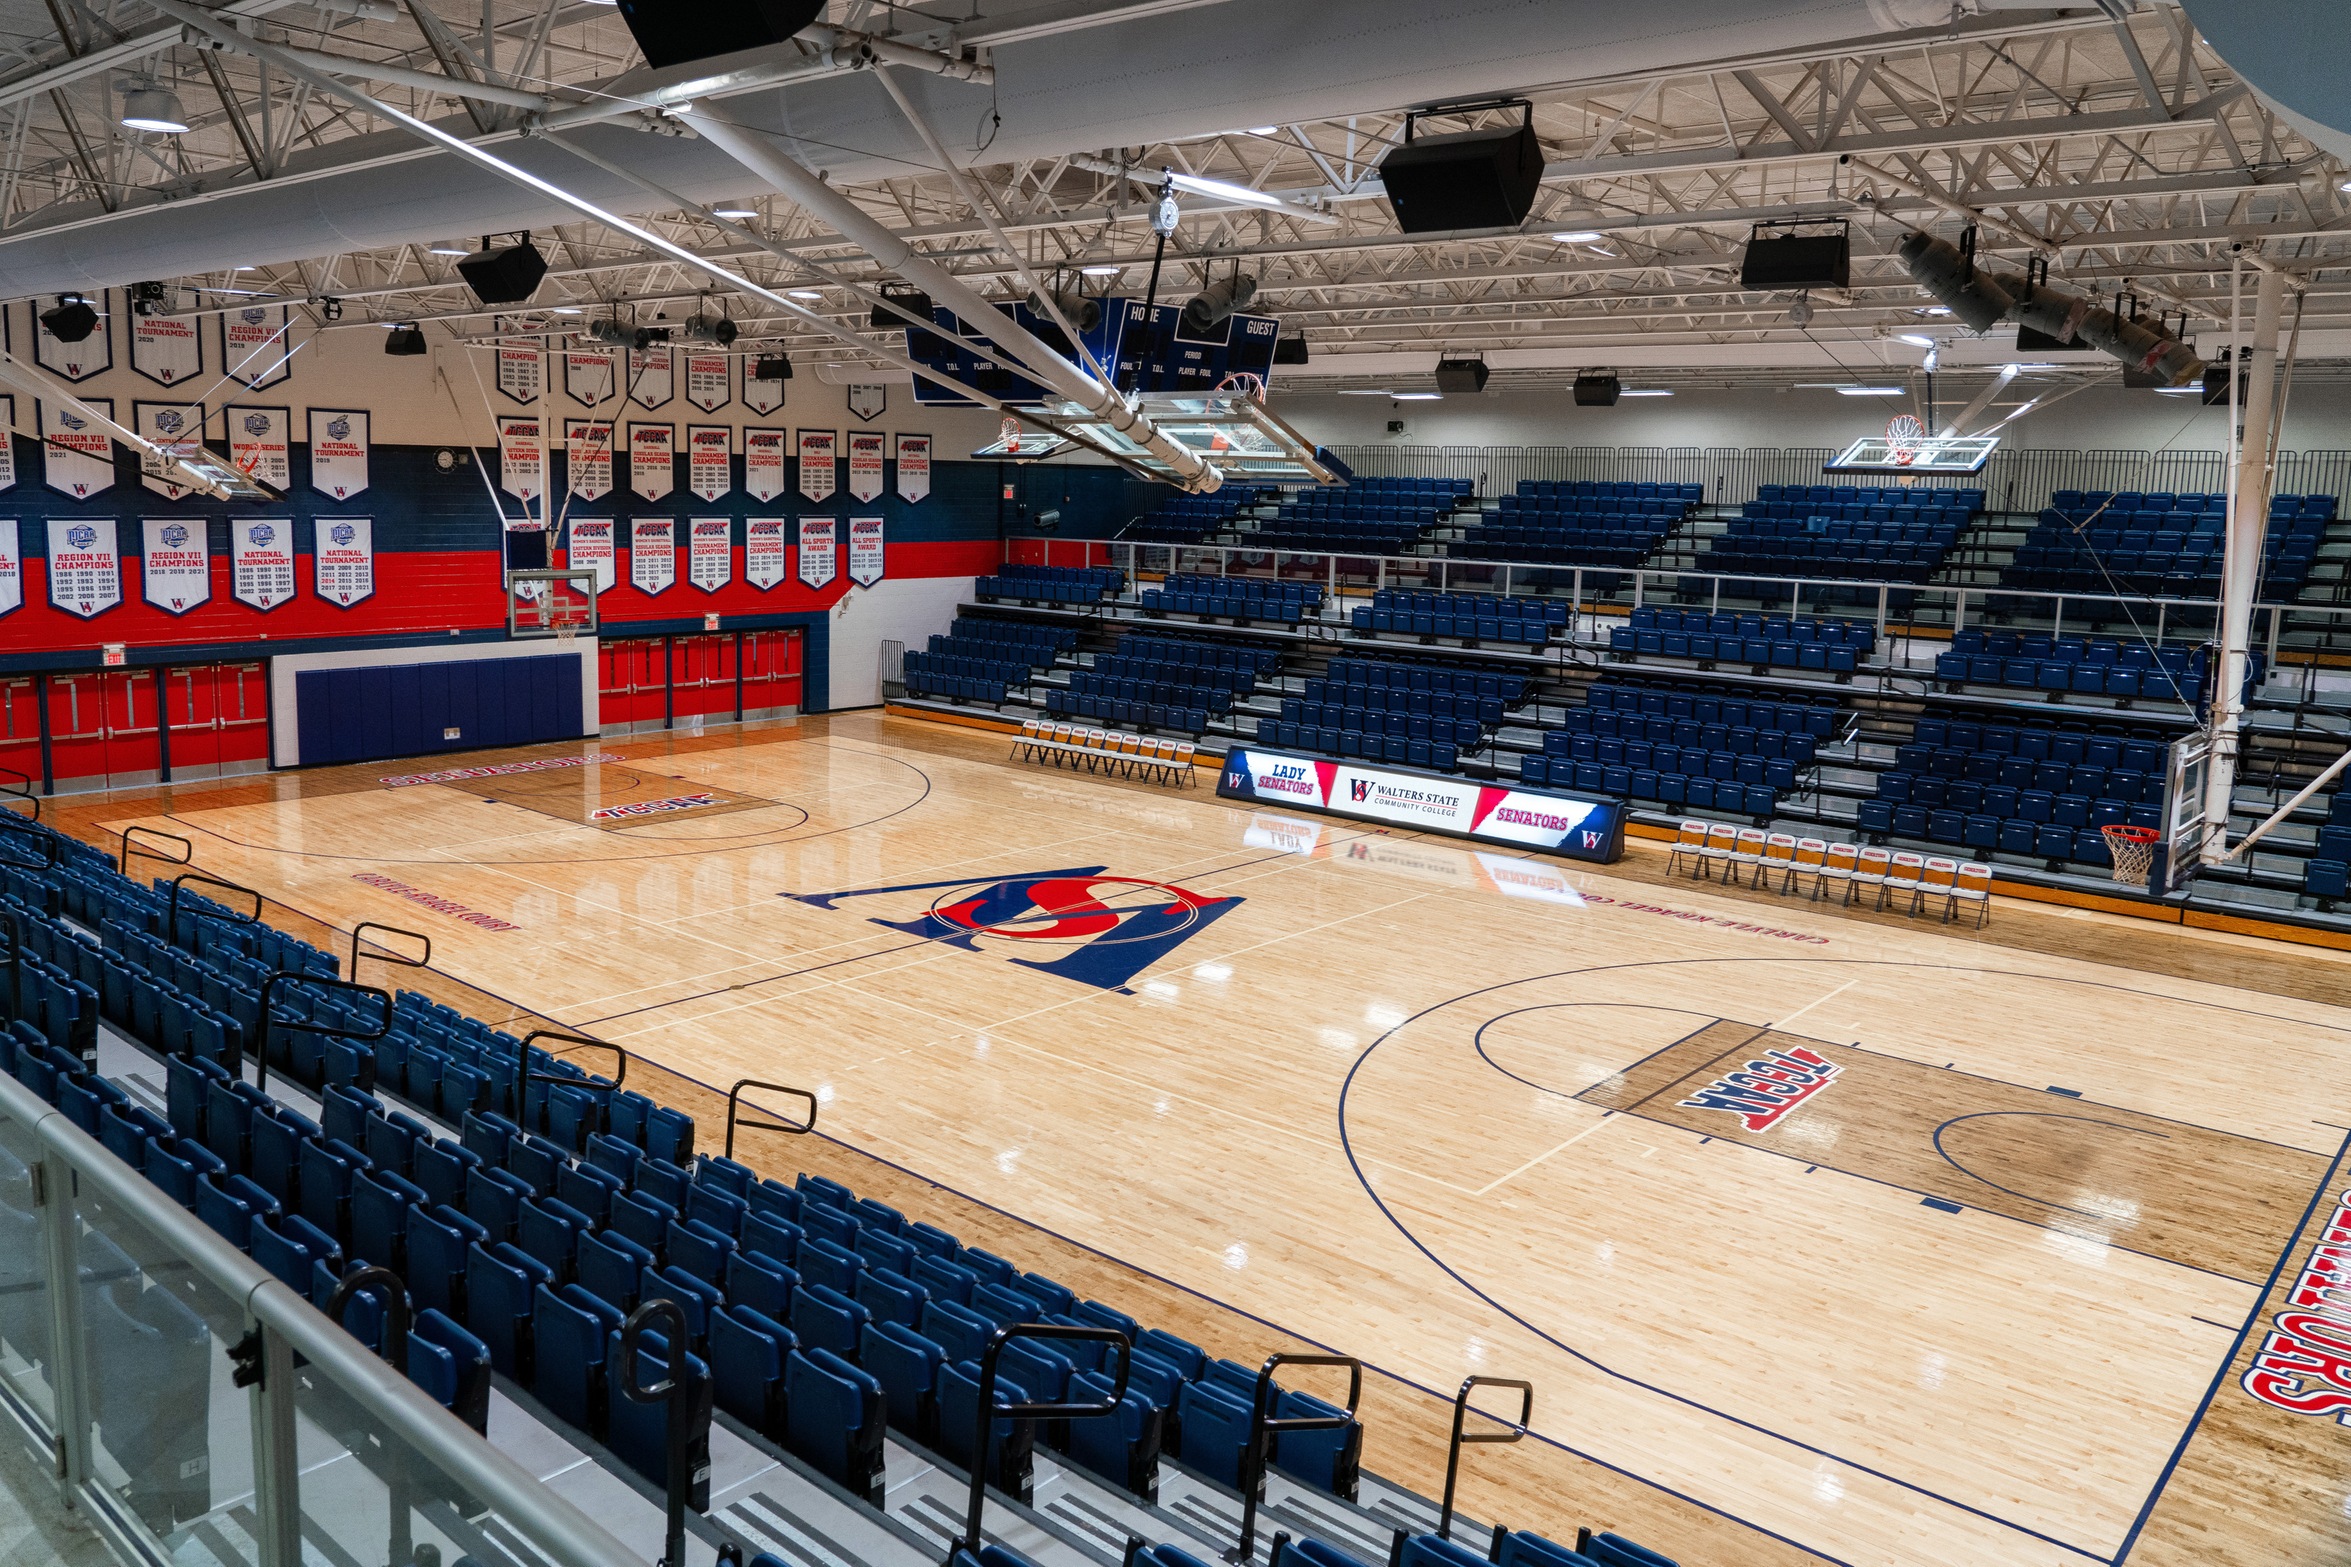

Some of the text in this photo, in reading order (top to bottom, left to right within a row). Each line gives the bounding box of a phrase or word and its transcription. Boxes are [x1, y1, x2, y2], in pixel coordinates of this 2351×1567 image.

[144, 320, 186, 329] NATIONAL
[231, 326, 264, 334] REGION
[1247, 321, 1275, 336] GUEST
[136, 328, 194, 337] TOURNAMENT
[229, 334, 281, 343] CHAMPIONS
[570, 357, 609, 365] CHAMPIONS
[1184, 350, 1202, 360] PERIOD
[1178, 367, 1196, 376] PLAYER
[638, 431, 667, 443] TCCAA
[697, 433, 725, 446] TCCAA
[752, 435, 780, 447] TCCAA
[806, 437, 831, 449] TCCAA
[576, 524, 609, 537] TCCAA
[639, 525, 669, 536] TCCAA
[698, 523, 725, 535] TCCAA
[753, 523, 780, 535] TCCAA
[806, 523, 831, 534] TCCAA
[856, 523, 879, 534] TCCAA
[67, 529, 97, 541] NJCAA
[55, 562, 113, 570] CHAMPIONS
[108, 653, 121, 664] EXIT
[1272, 764, 1306, 780] LADY
[1258, 775, 1314, 795] SENATORS
[1378, 786, 1459, 806] WALTERS STATE
[1374, 798, 1456, 817] COMMUNITY COLLEGE
[1497, 807, 1569, 831] SENATORS
[1675, 1048, 1834, 1116] TCCAA
[189, 1460, 199, 1474] H
[699, 1469, 705, 1480] F
[875, 1476, 881, 1484] E
[1025, 1477, 1030, 1486] D
